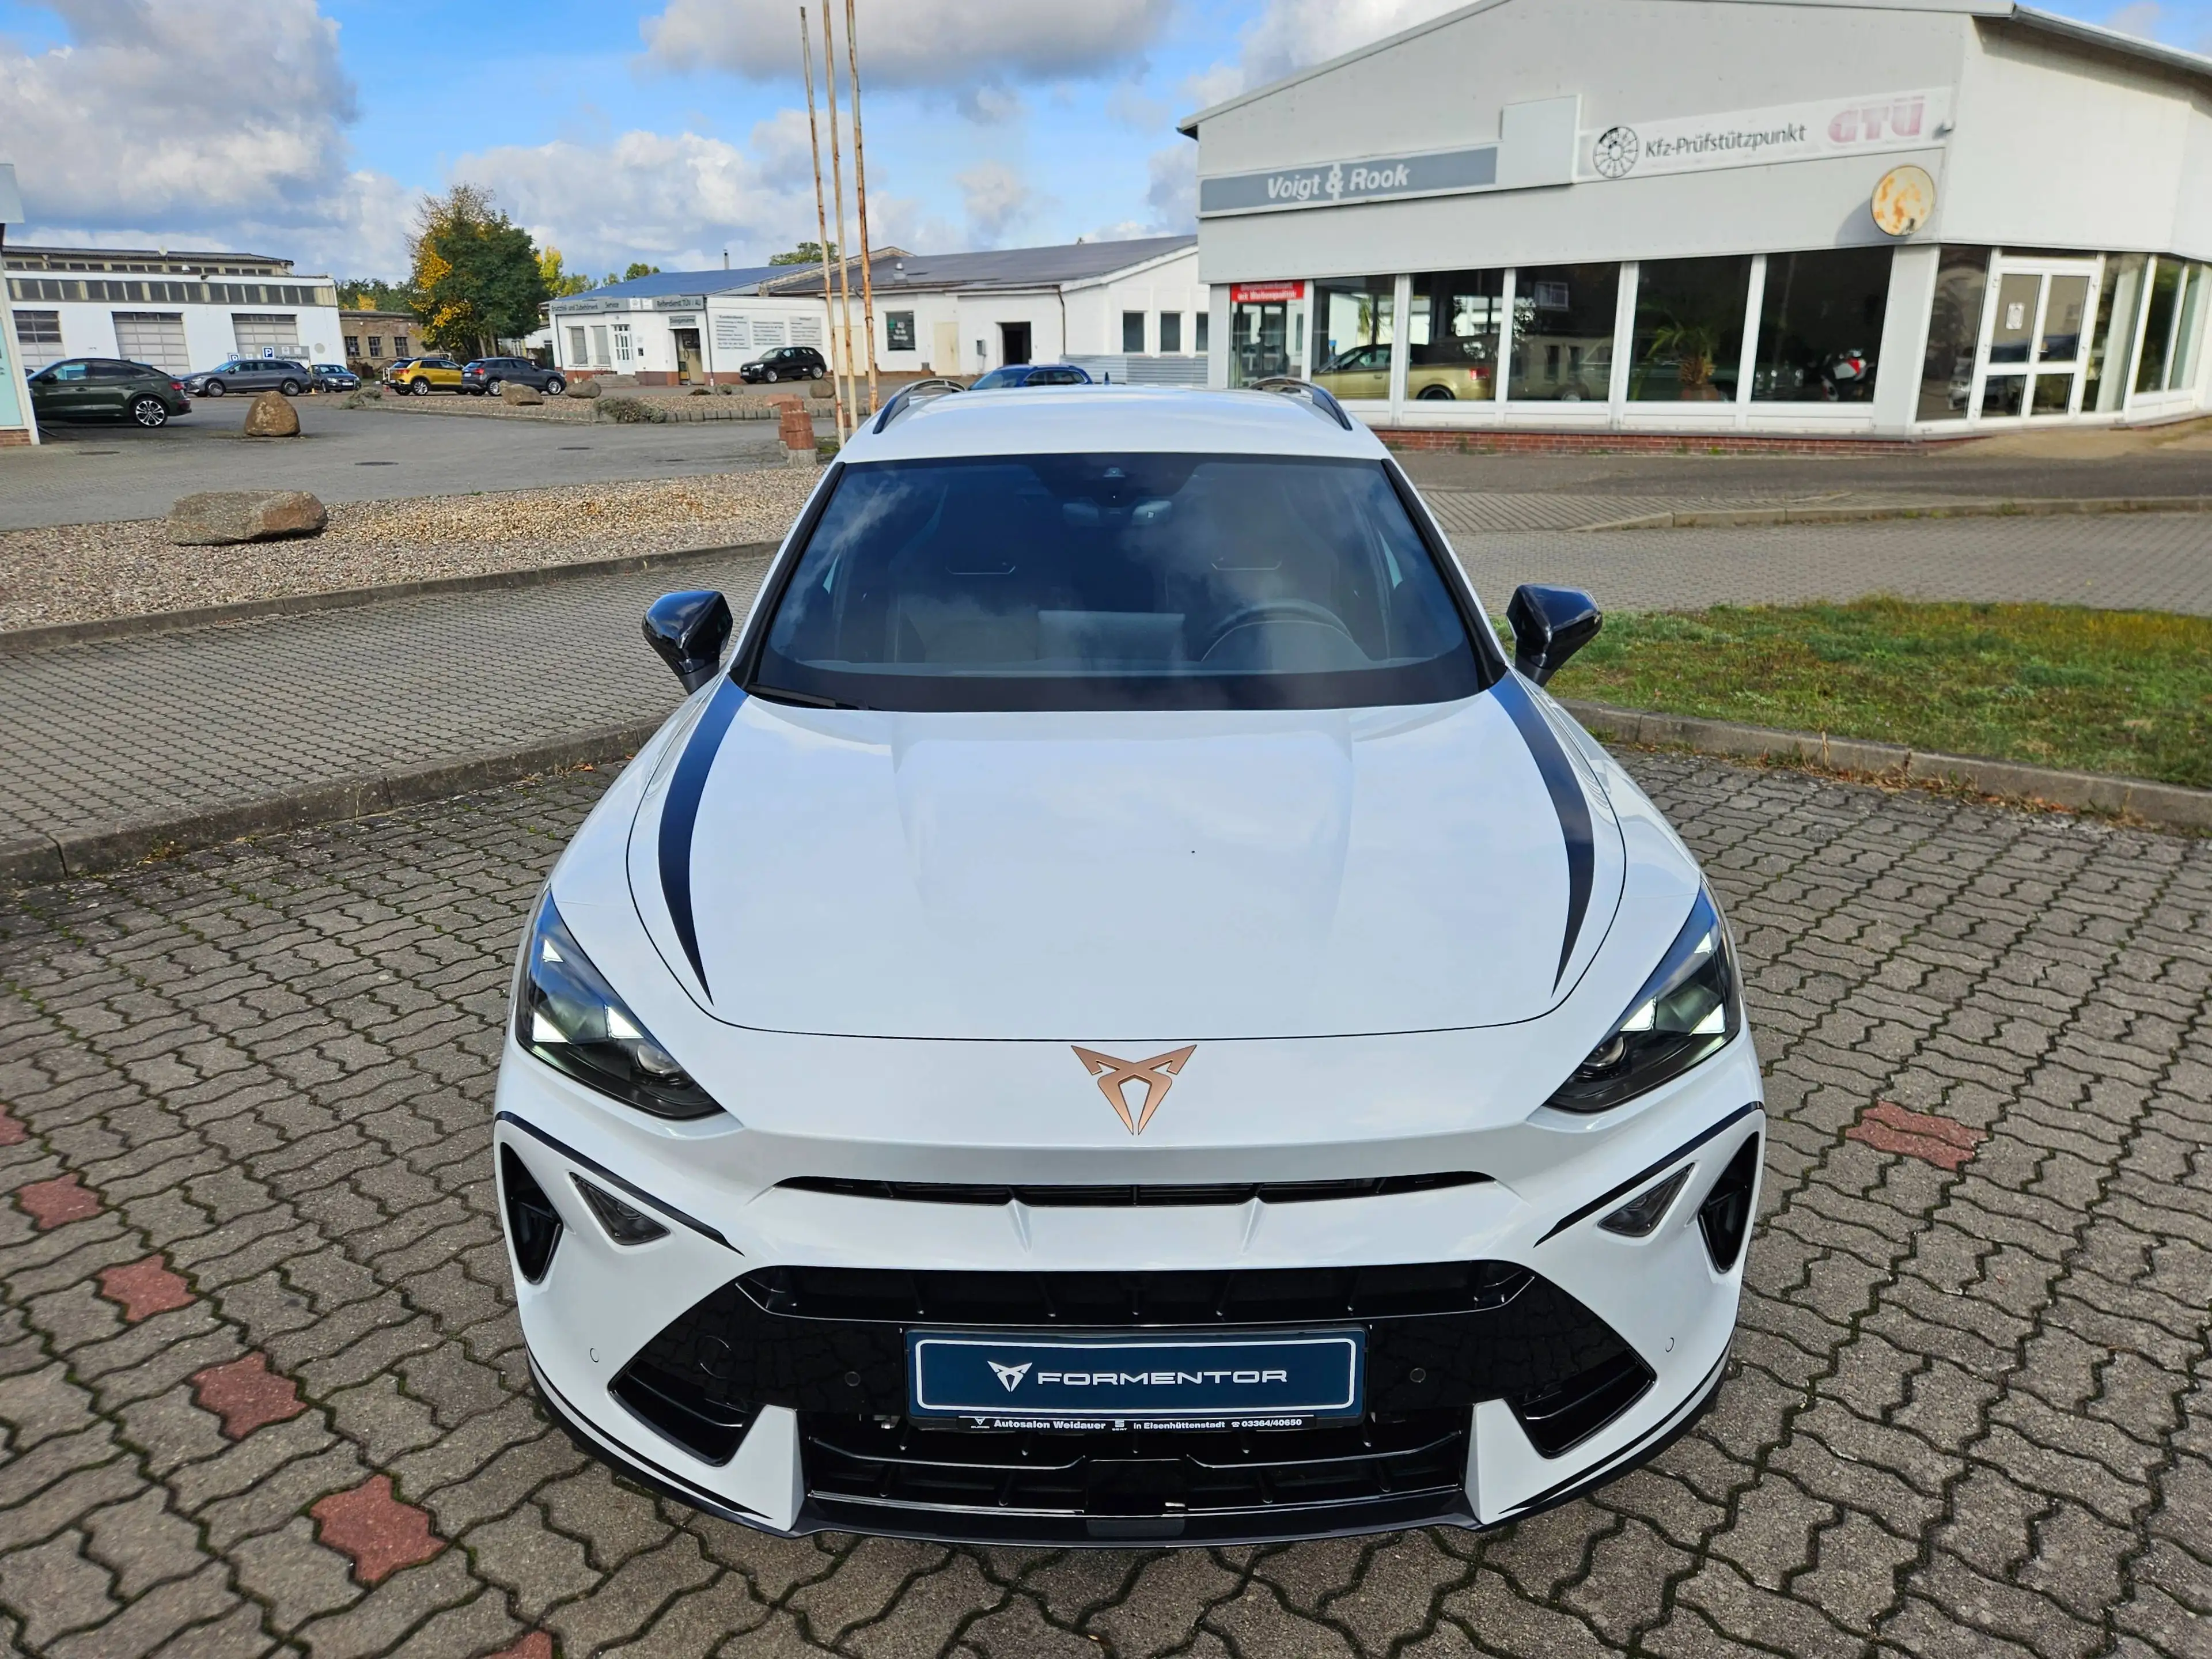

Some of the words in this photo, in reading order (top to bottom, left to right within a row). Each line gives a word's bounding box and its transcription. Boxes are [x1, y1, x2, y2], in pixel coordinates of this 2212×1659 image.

[1827, 96, 1925, 143] GTÜ
[1645, 123, 1807, 157] Kfz-Prüfstützpunkt
[1267, 175, 1320, 200] Voigt
[1325, 171, 1344, 194] &
[1349, 164, 1410, 191] Rook
[1037, 1370, 1287, 1385] FORMENTOR
[994, 1419, 1050, 1429] Autosalon
[1143, 1421, 1225, 1430] Eisenhüttenstadt
[1241, 1419, 1302, 1427] 03364/40650
